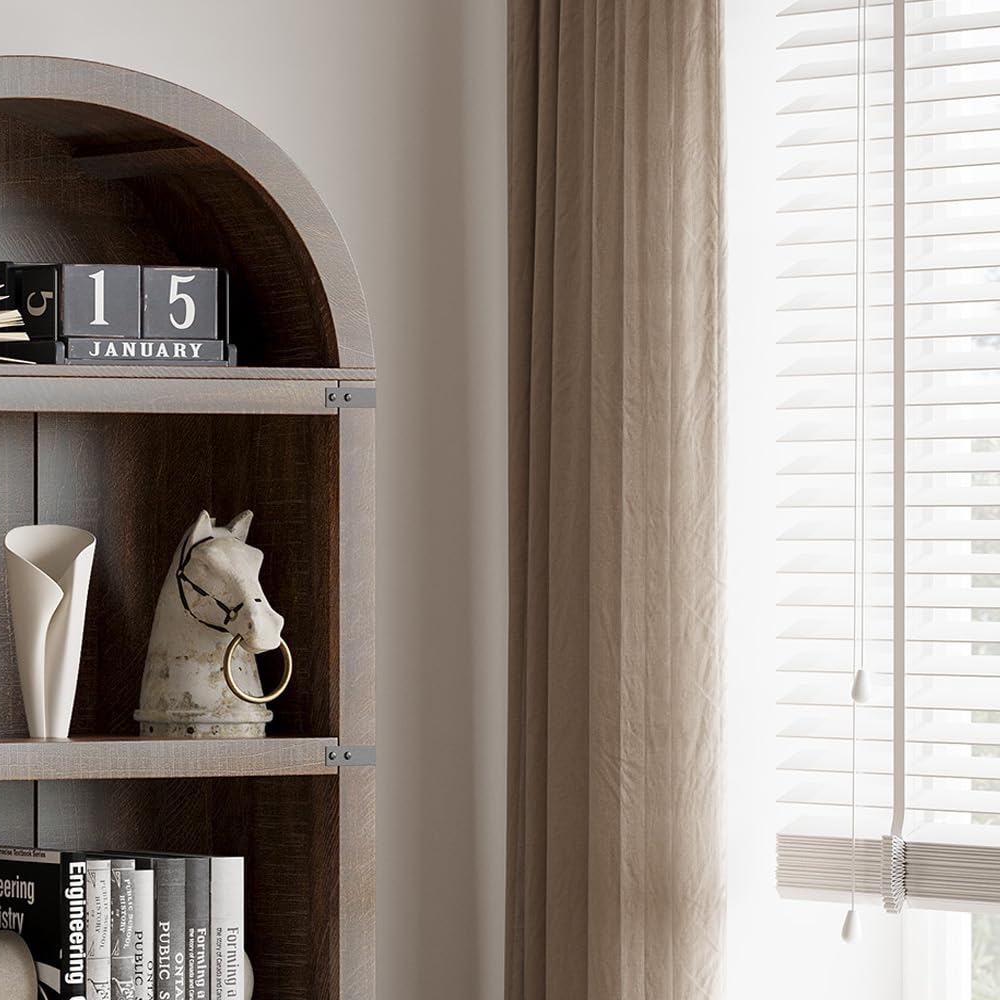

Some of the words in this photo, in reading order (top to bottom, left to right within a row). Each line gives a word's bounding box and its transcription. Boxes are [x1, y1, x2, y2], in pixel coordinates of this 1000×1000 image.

[88, 269, 110, 326] 1
[169, 274, 196, 330] 5
[89, 341, 203, 358] JANUARY
[65, 862, 87, 985] Engineering
[159, 921, 170, 980] PUBLIC
[134, 931, 143, 986] PUBLIC
[195, 927, 207, 987] Forming
[224, 927, 240, 986] Forming
[197, 990, 205, 999] a
[227, 989, 237, 997] a
